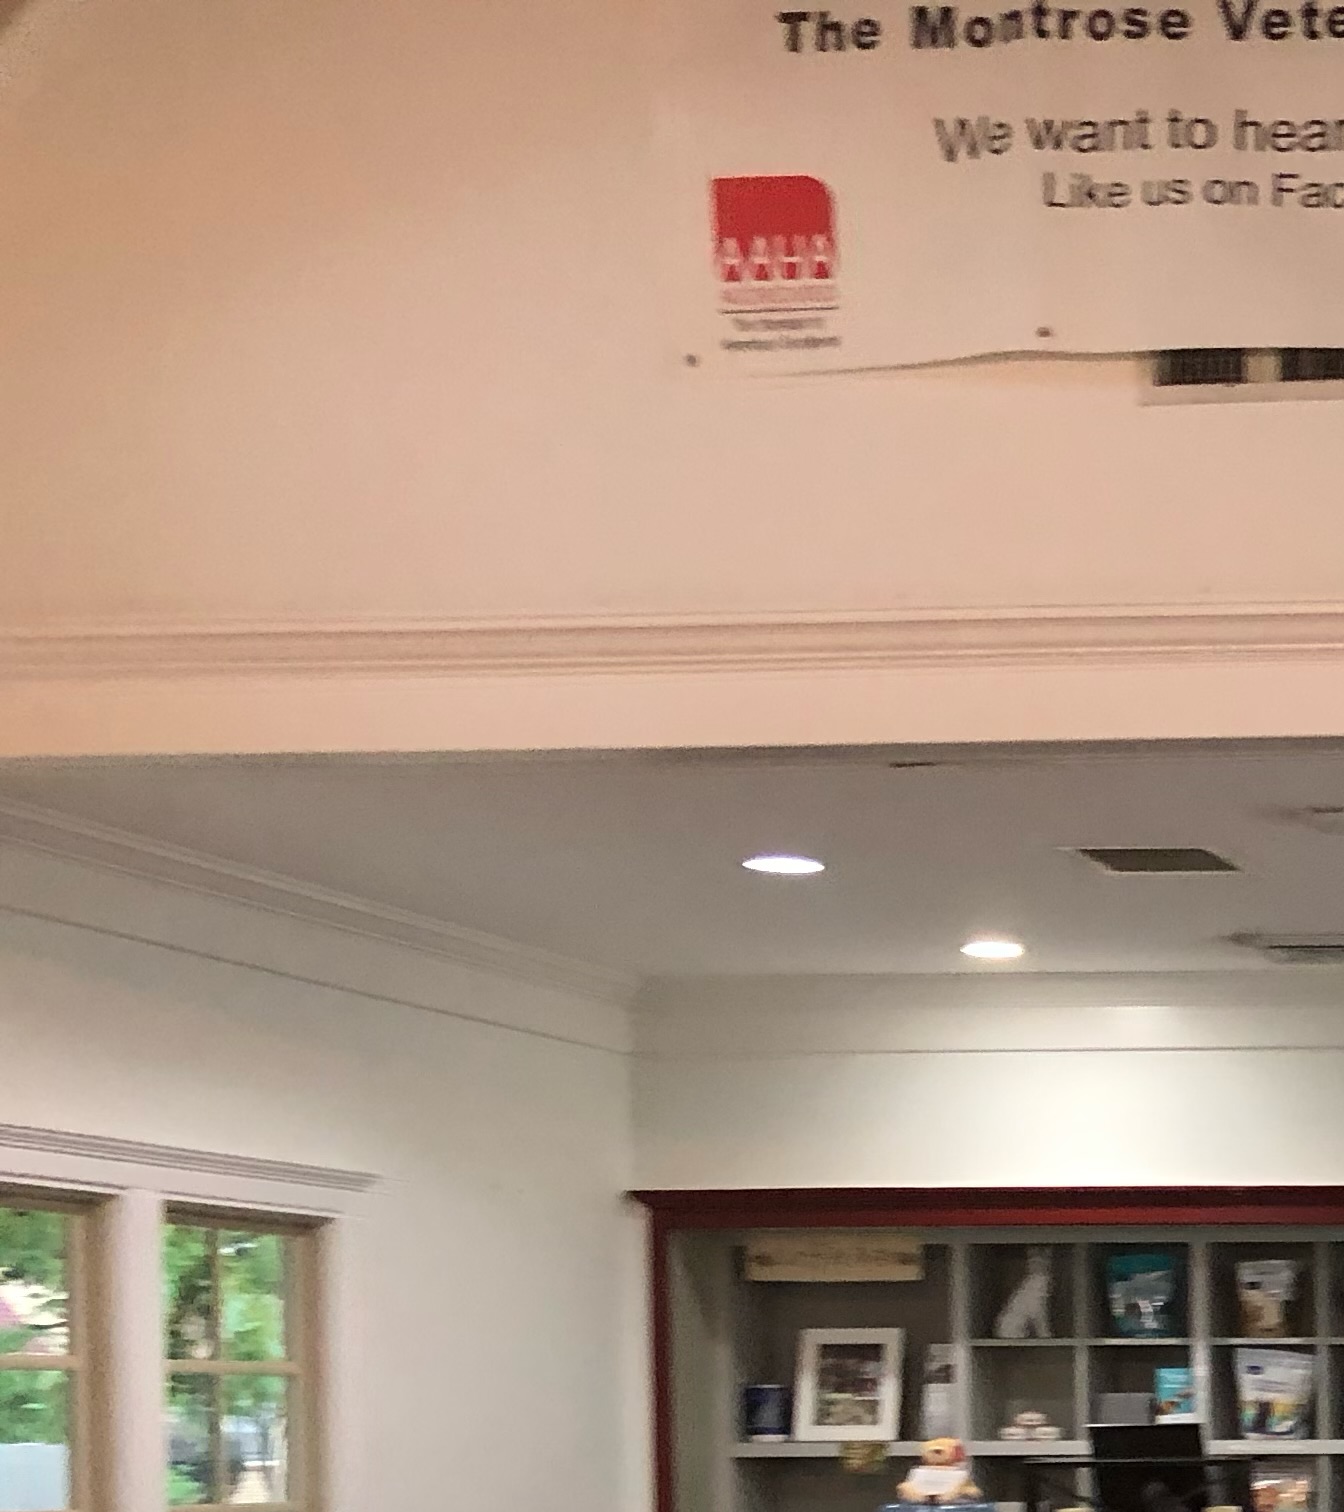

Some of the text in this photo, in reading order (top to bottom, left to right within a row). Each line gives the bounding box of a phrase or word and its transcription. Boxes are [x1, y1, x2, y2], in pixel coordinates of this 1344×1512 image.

[774, 10, 883, 53] The
[908, 0, 1193, 50] Montrose
[932, 115, 1012, 162] We
[1024, 109, 1155, 153] want
[1166, 108, 1217, 150] to
[1041, 172, 1132, 208] Like
[1140, 178, 1193, 205] us
[1202, 178, 1259, 206] on
